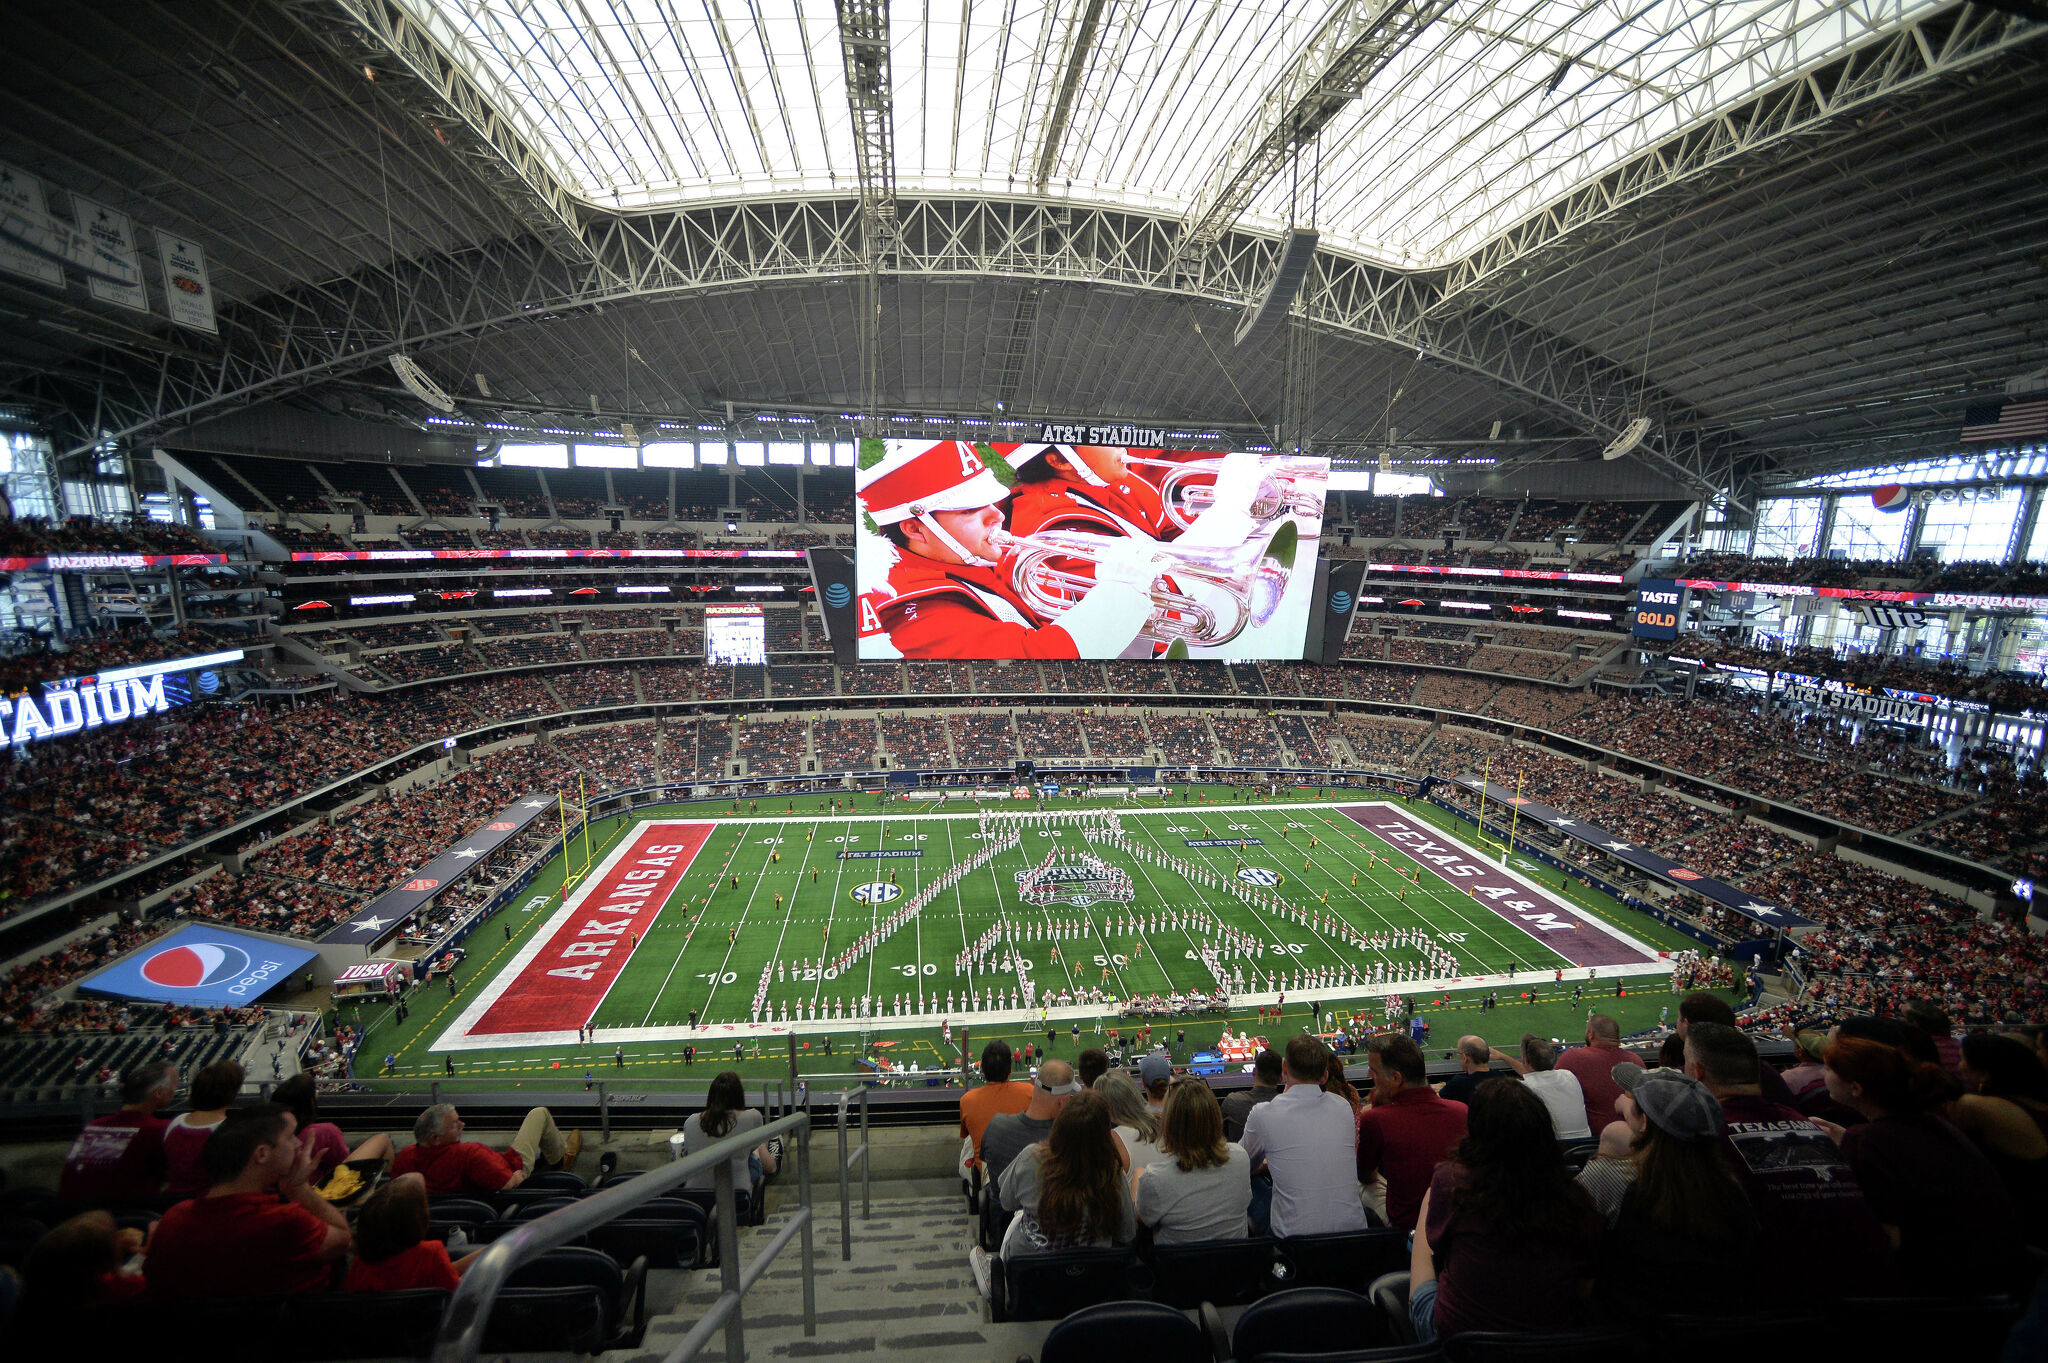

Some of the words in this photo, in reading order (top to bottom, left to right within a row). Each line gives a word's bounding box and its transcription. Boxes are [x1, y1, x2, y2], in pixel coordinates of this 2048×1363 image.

[1042, 425, 1085, 443] AT&T
[1089, 426, 1165, 446] STADIUM
[1919, 483, 2003, 509] pepsi
[1641, 591, 1678, 604] TASTE
[1731, 595, 1748, 607] Lite
[1806, 597, 1825, 612] Lite
[861, 597, 882, 632] A
[1637, 612, 1676, 627] GOLD
[1859, 605, 1927, 631] Lite
[64, 679, 77, 688] 17
[1784, 684, 1828, 706] AT&T
[1830, 691, 1922, 720] STADIUM
[1902, 692, 1913, 700] 17
[1953, 700, 1989, 710] COWBOYS
[834, 835, 860, 843] 20
[1237, 868, 1283, 886] SEC
[1376, 822, 1485, 877] TEXAS
[1474, 885, 1577, 931] A&M
[854, 883, 899, 903] SEC
[1070, 895, 1092, 904] SEC
[546, 844, 685, 980] ARKANSAS
[1437, 932, 1466, 943] 10
[1270, 944, 1303, 955] 30
[1094, 954, 1125, 966] 50
[341, 962, 391, 979] TUSK
[902, 964, 937, 976] 30
[228, 960, 283, 996] pepsi
[706, 972, 737, 985] 10
